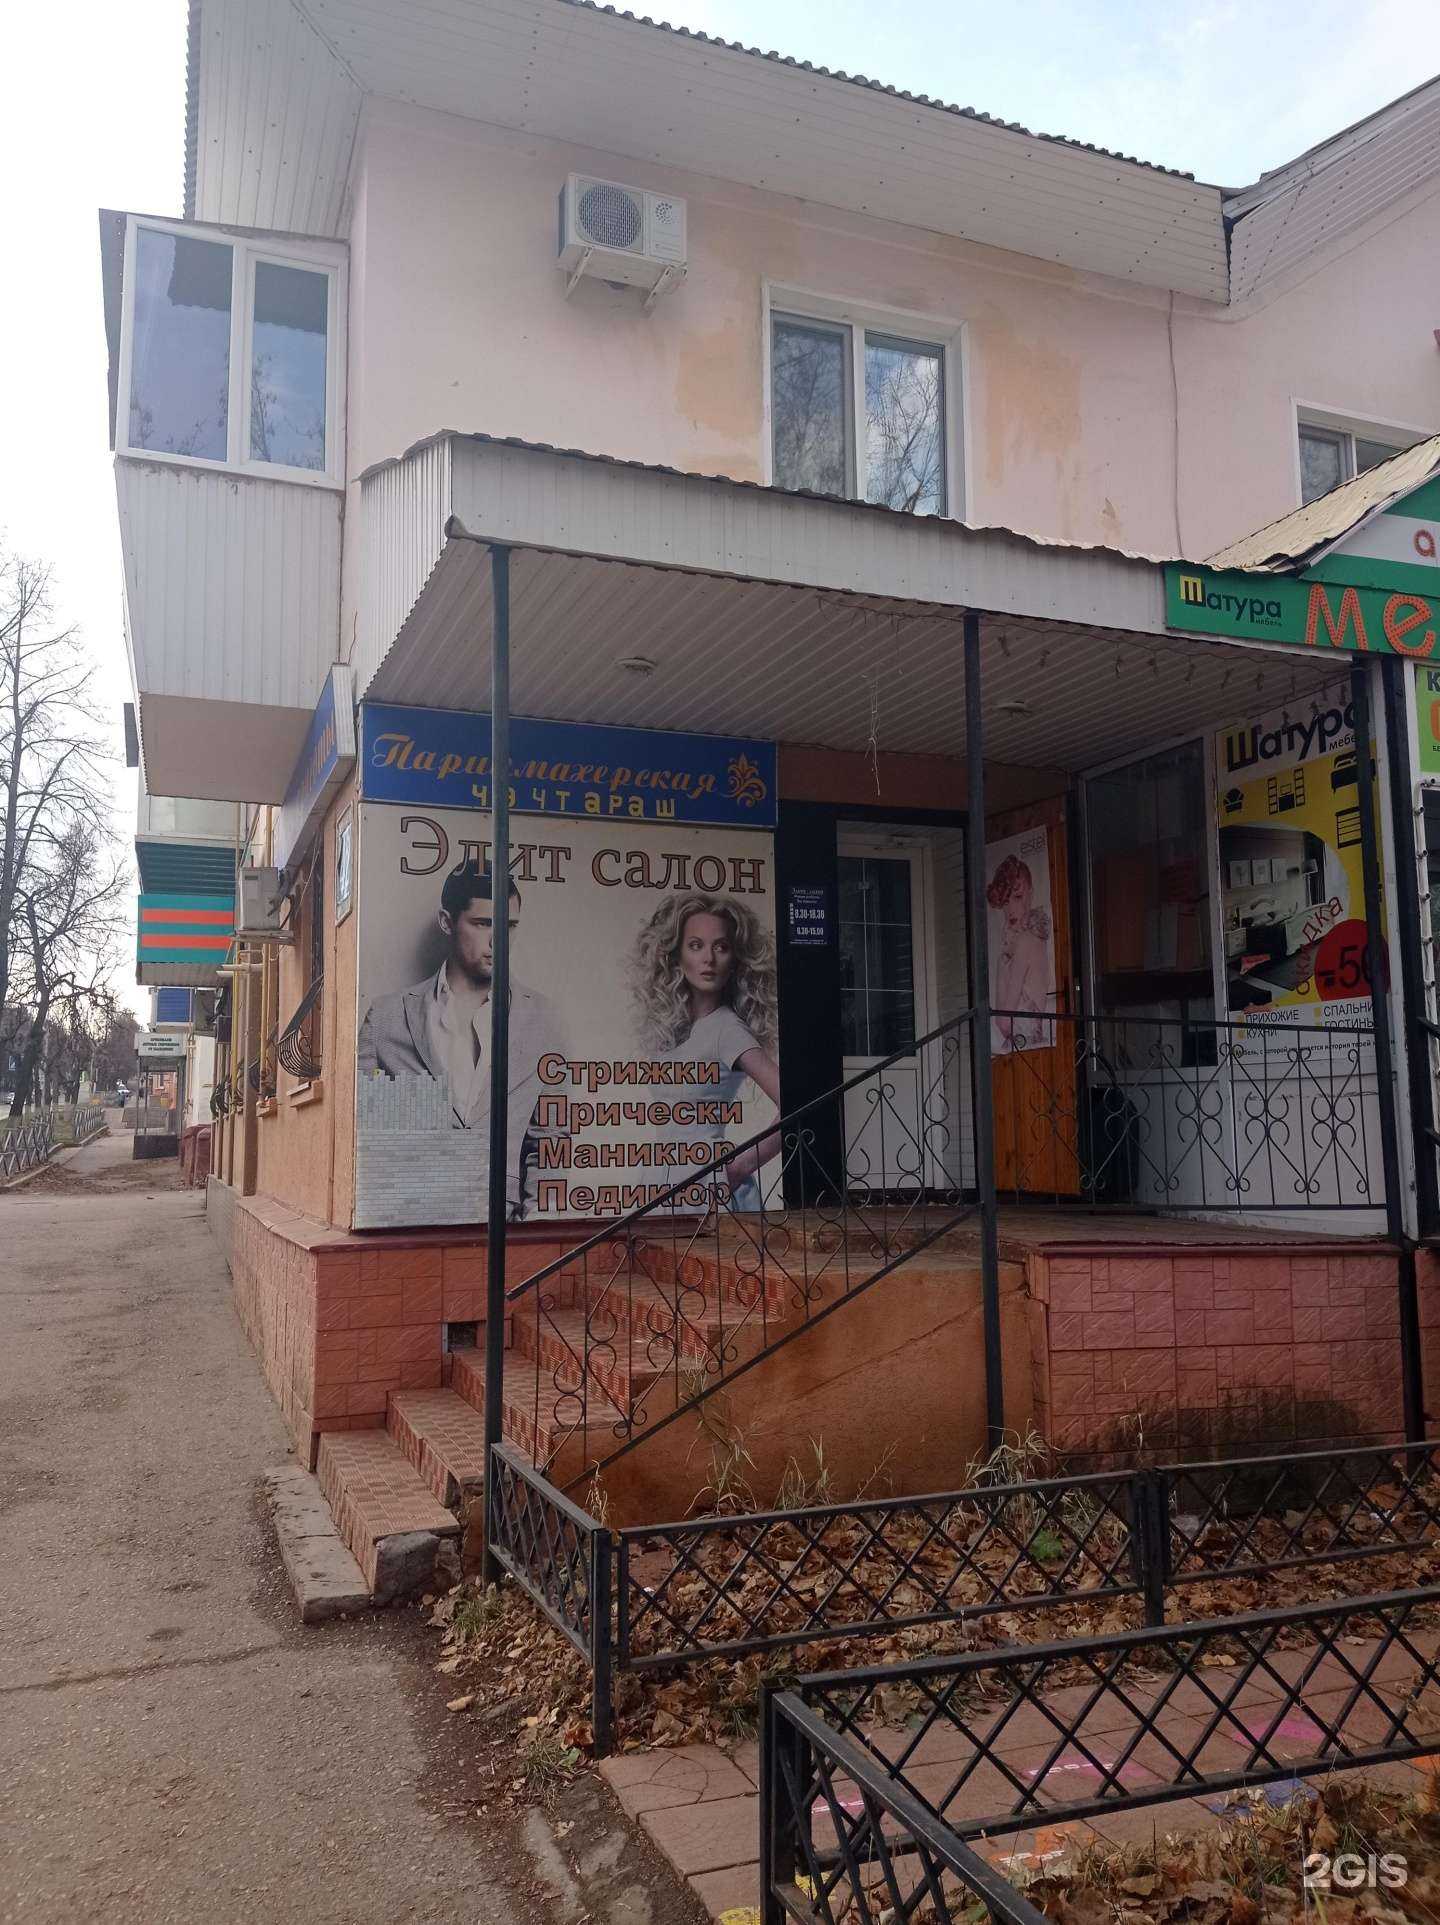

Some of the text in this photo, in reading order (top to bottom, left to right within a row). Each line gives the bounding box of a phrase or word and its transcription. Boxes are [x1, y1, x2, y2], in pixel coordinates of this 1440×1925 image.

[1180, 575, 1282, 622] Шатура
[372, 733, 718, 799] Паримахерская
[400, 815, 767, 893] Элит салон
[537, 1053, 720, 1093] Стрижки
[537, 1095, 743, 1134] Прически
[537, 1136, 736, 1172] Маникюр
[537, 1179, 732, 1215] Педикюр
